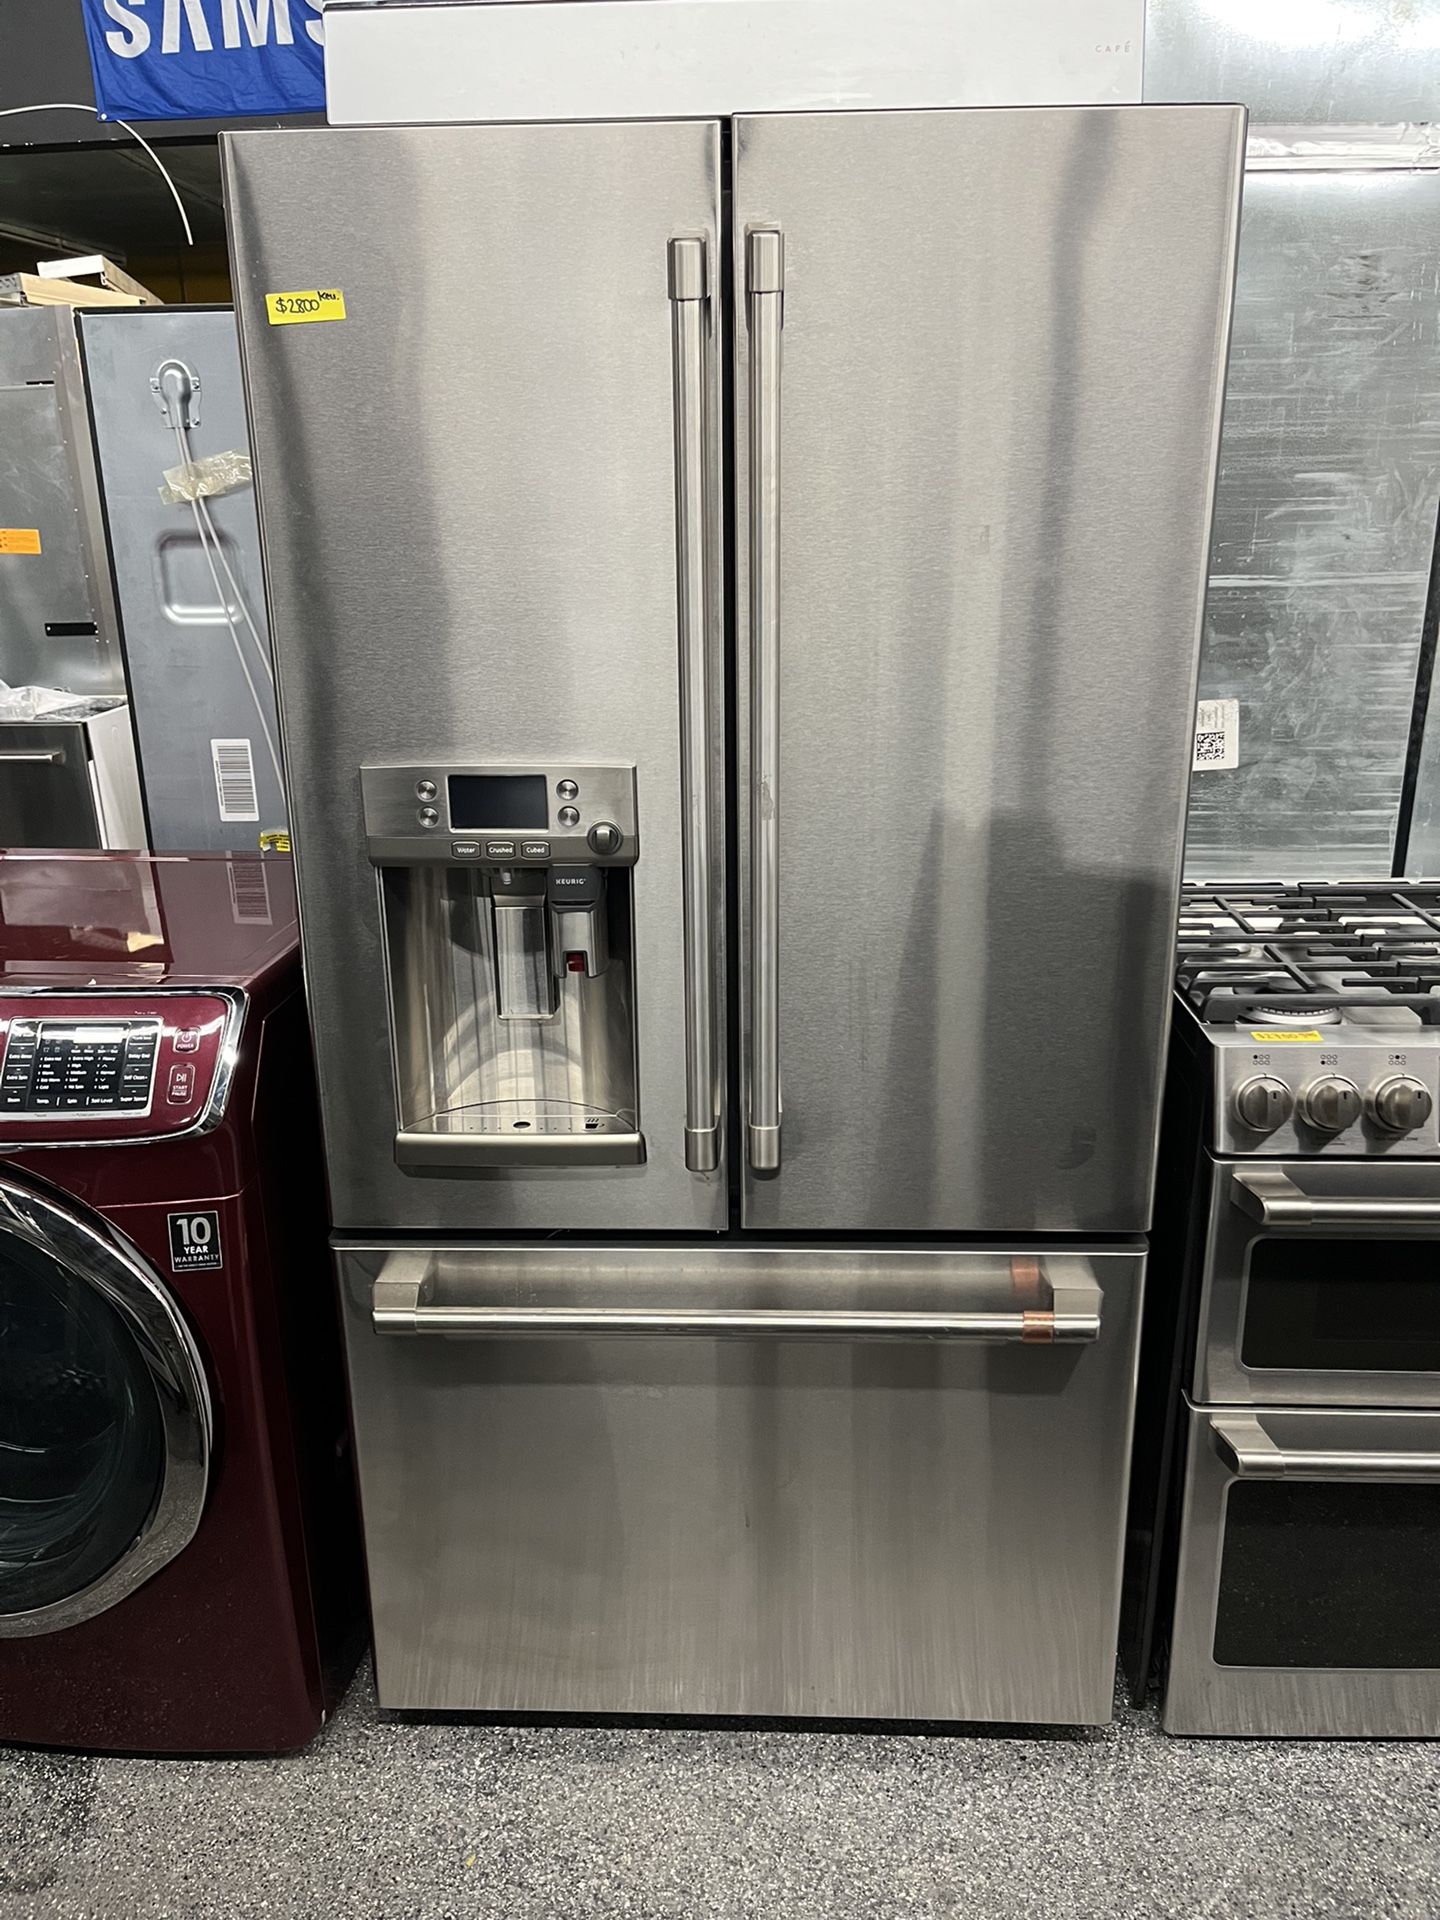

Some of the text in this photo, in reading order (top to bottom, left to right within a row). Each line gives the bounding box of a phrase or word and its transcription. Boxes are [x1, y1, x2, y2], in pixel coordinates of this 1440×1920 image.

[276, 297, 320, 314] $2800
[176, 1216, 211, 1245] 10
[183, 1245, 209, 1254] YEAR
[174, 1254, 219, 1263] WARRANTY
